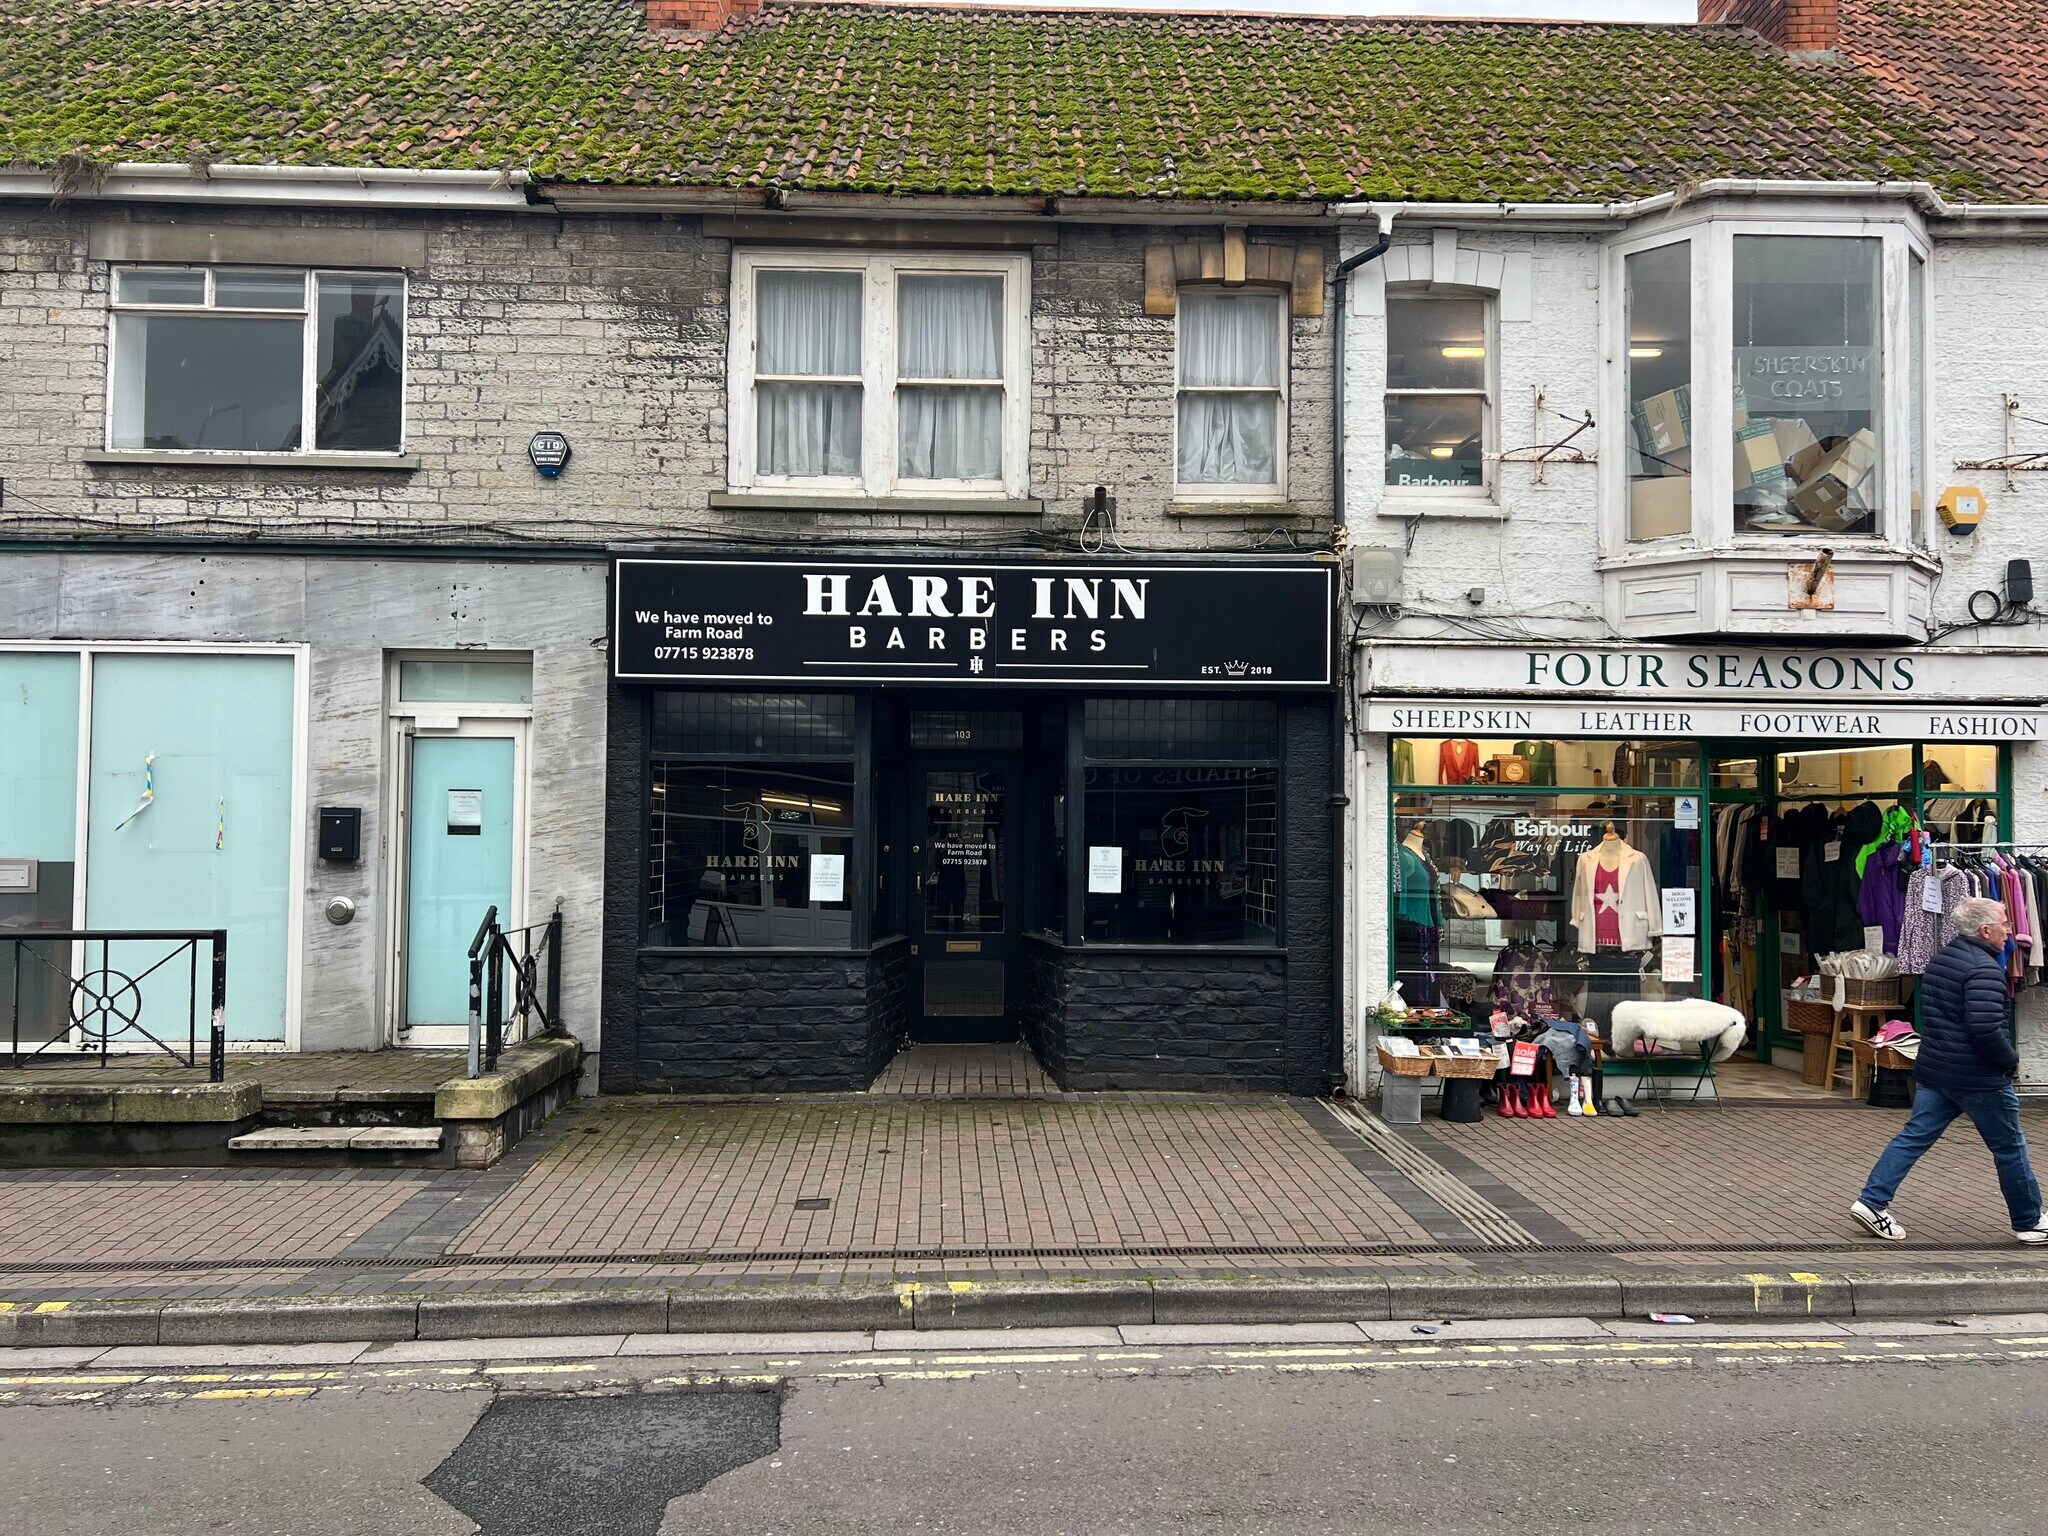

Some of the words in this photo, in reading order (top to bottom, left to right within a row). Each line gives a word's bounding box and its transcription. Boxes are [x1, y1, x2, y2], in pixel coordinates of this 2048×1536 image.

[1771, 380, 1842, 397] COATS
[537, 441, 560, 449] CID
[803, 574, 996, 618] HARE
[1031, 578, 1149, 620] INN
[635, 611, 660, 623] We
[664, 611, 699, 624] have
[704, 612, 753, 625] moved
[757, 613, 773, 625] to
[665, 626, 702, 639] Farm
[706, 627, 743, 640] Road
[850, 627, 1106, 652] BARBERS
[654, 647, 698, 659] 07715
[702, 648, 754, 660] 923878
[1201, 666, 1222, 674] EST.
[1250, 666, 1272, 675] 2018
[1526, 652, 1669, 689] FOUR
[1687, 652, 1915, 691] SEASONS
[1391, 708, 1532, 729] SHEEPSKIN
[1580, 710, 1692, 731] LEATHER
[1740, 714, 1881, 733] FOOTWEAR
[1929, 716, 2038, 736] FASHION
[955, 731, 971, 739] 103
[935, 793, 971, 802] HARE
[976, 793, 999, 802] INN
[1515, 840, 1541, 856] Way
[1546, 840, 1561, 856] of
[1564, 840, 1593, 856] Life
[706, 855, 759, 868] HARE
[767, 855, 799, 868] INN
[963, 858, 988, 866] 923878
[1134, 859, 1186, 872] HARE
[1193, 860, 1225, 873] INN
[1515, 1046, 1537, 1057] sale
